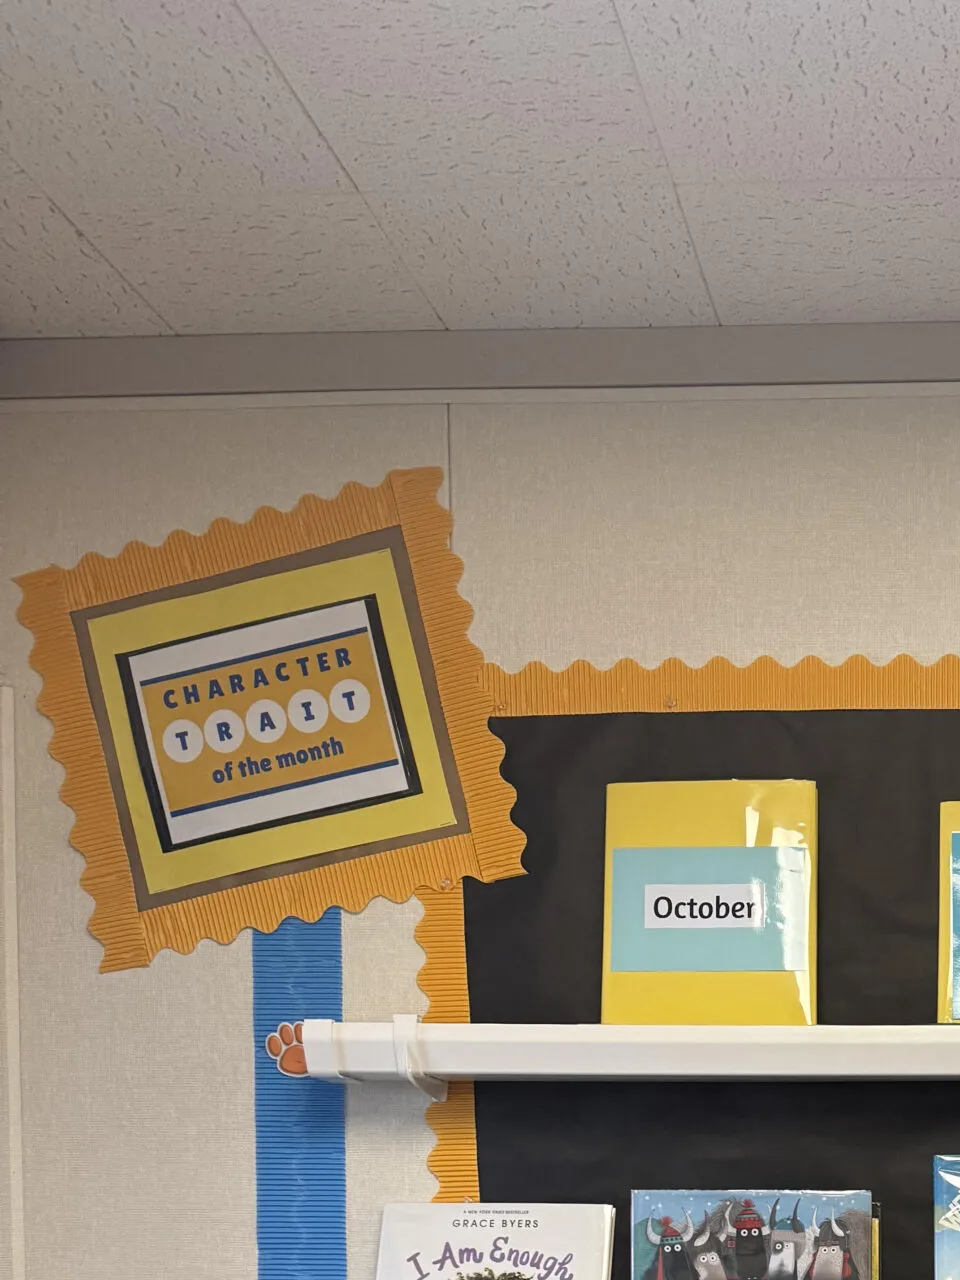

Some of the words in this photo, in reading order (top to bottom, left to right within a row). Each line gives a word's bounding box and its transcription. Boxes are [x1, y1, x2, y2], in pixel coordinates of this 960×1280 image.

[163, 648, 351, 708] CHARACTER
[176, 691, 356, 750] TRAIT
[212, 761, 233, 784] of
[238, 756, 272, 778] the
[275, 736, 344, 769] month
[653, 896, 755, 919] October
[452, 1219, 495, 1228] GRACE
[501, 1219, 539, 1228] BYERS
[432, 1241, 484, 1271] Am
